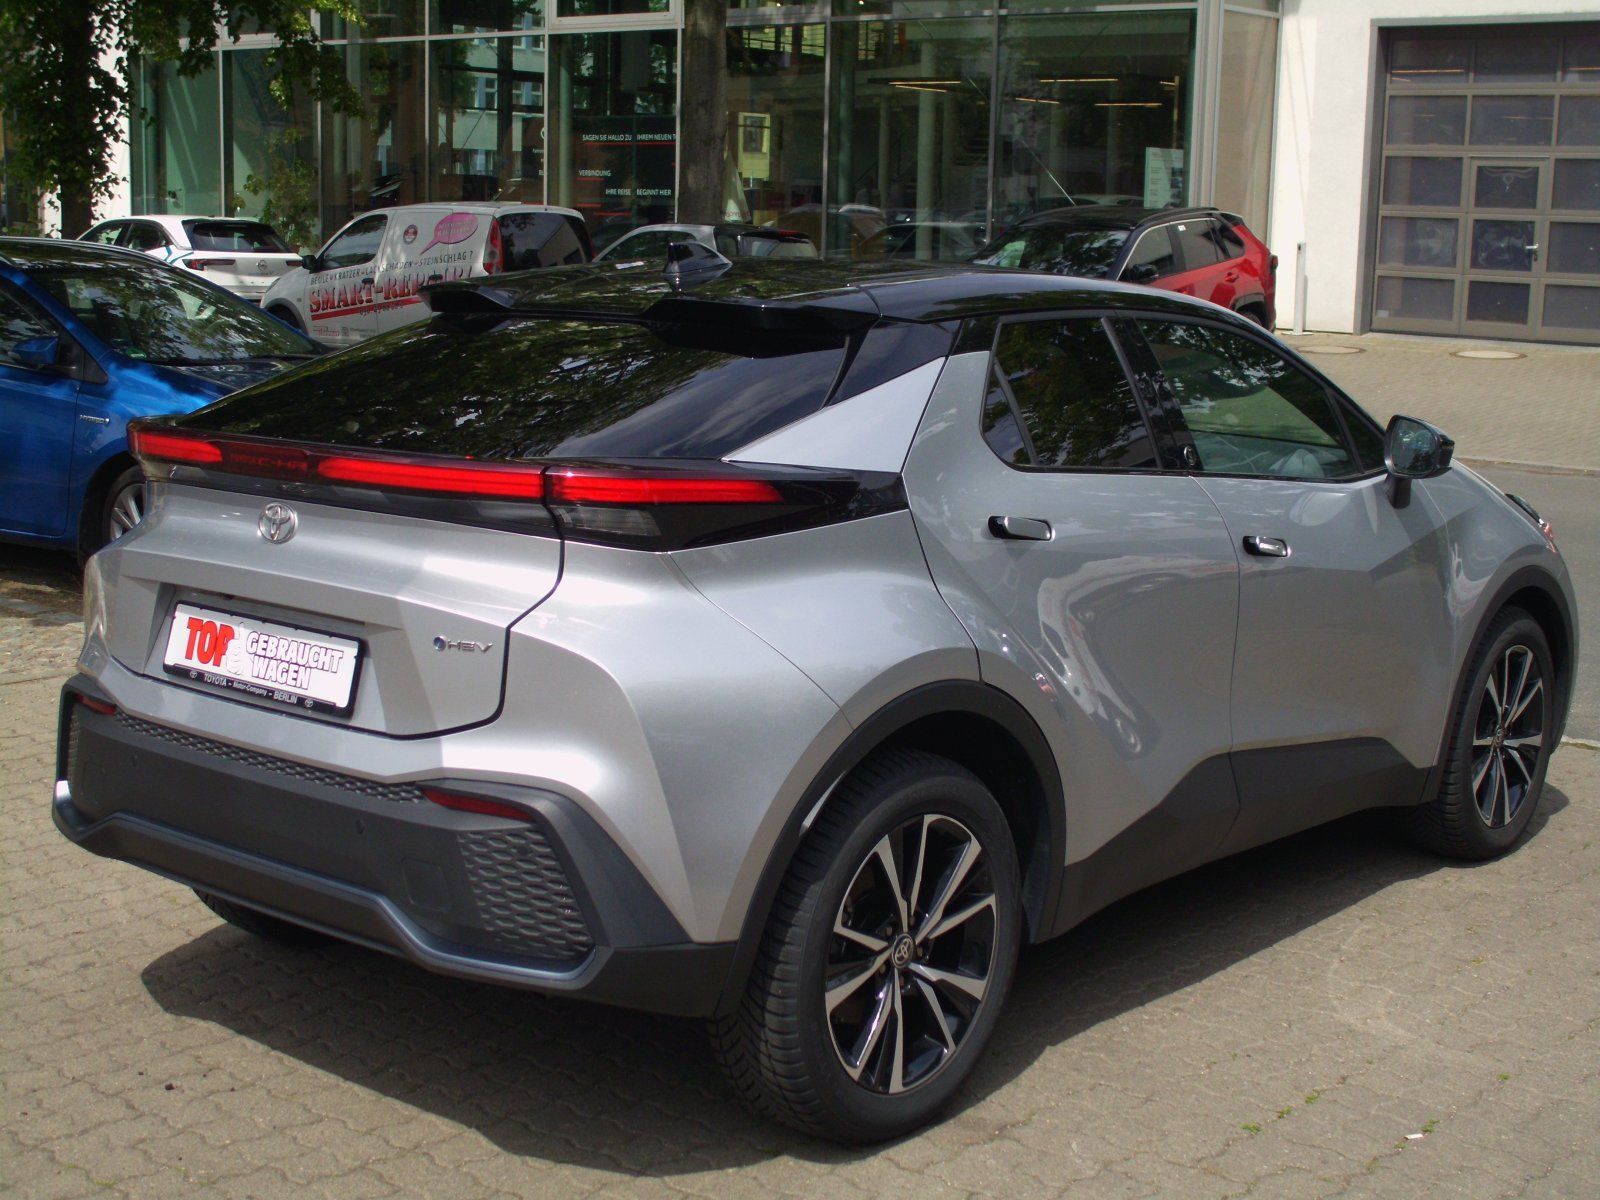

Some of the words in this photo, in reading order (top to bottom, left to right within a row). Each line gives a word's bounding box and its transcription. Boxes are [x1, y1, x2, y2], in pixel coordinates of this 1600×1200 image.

[578, 169, 612, 177] VERBINDUNG
[636, 188, 659, 196] BEGINNT
[310, 274, 329, 285] BEULE
[418, 250, 467, 266] STEINSCHLAG
[185, 616, 235, 667] TOP
[246, 630, 344, 673] GEBRAUCHT
[204, 673, 227, 687] TOYOTA
[233, 681, 267, 696] Motor-Company
[273, 689, 298, 704] BERLIN
[252, 655, 312, 690] WAGEN
